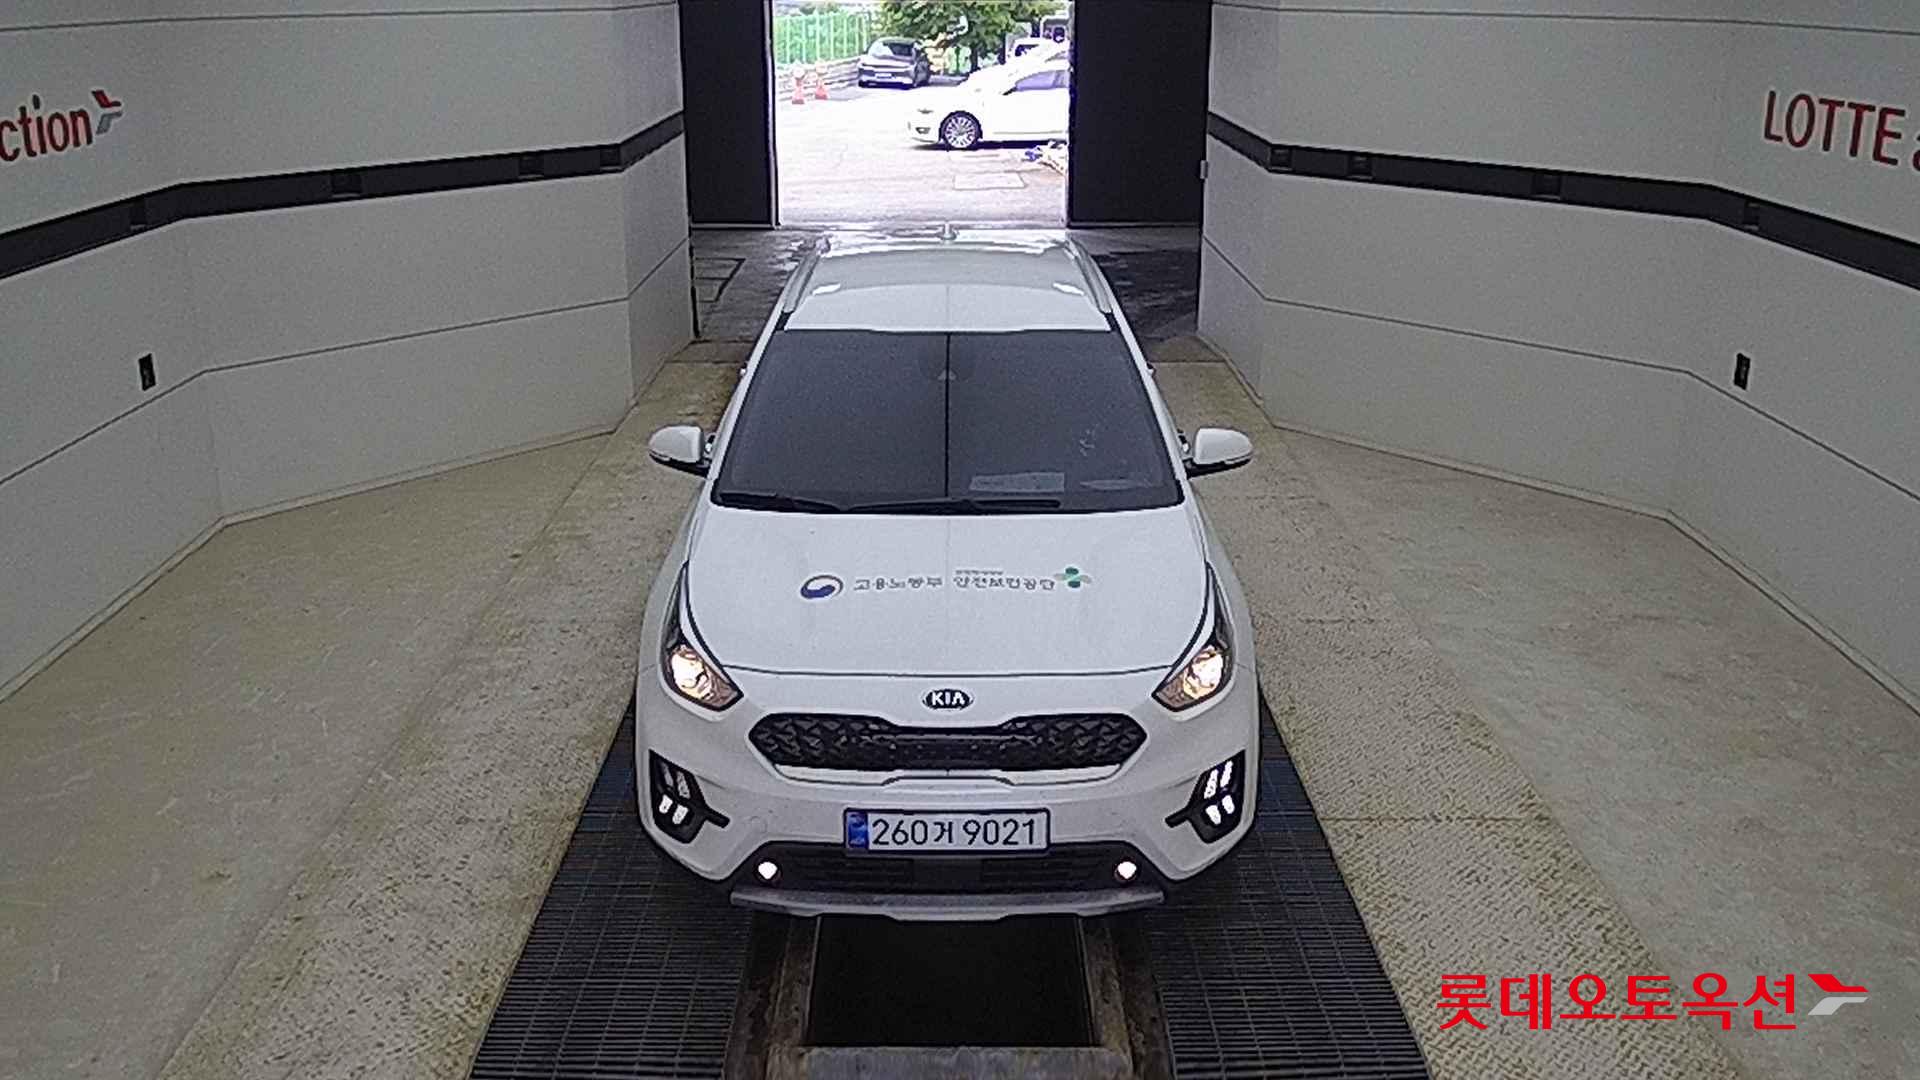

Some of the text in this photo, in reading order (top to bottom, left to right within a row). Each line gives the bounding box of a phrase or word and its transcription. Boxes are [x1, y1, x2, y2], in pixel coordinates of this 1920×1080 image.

[1764, 90, 1906, 165] LOTTE
[931, 691, 966, 706] KIA
[872, 818, 1035, 845] 260거 9021
